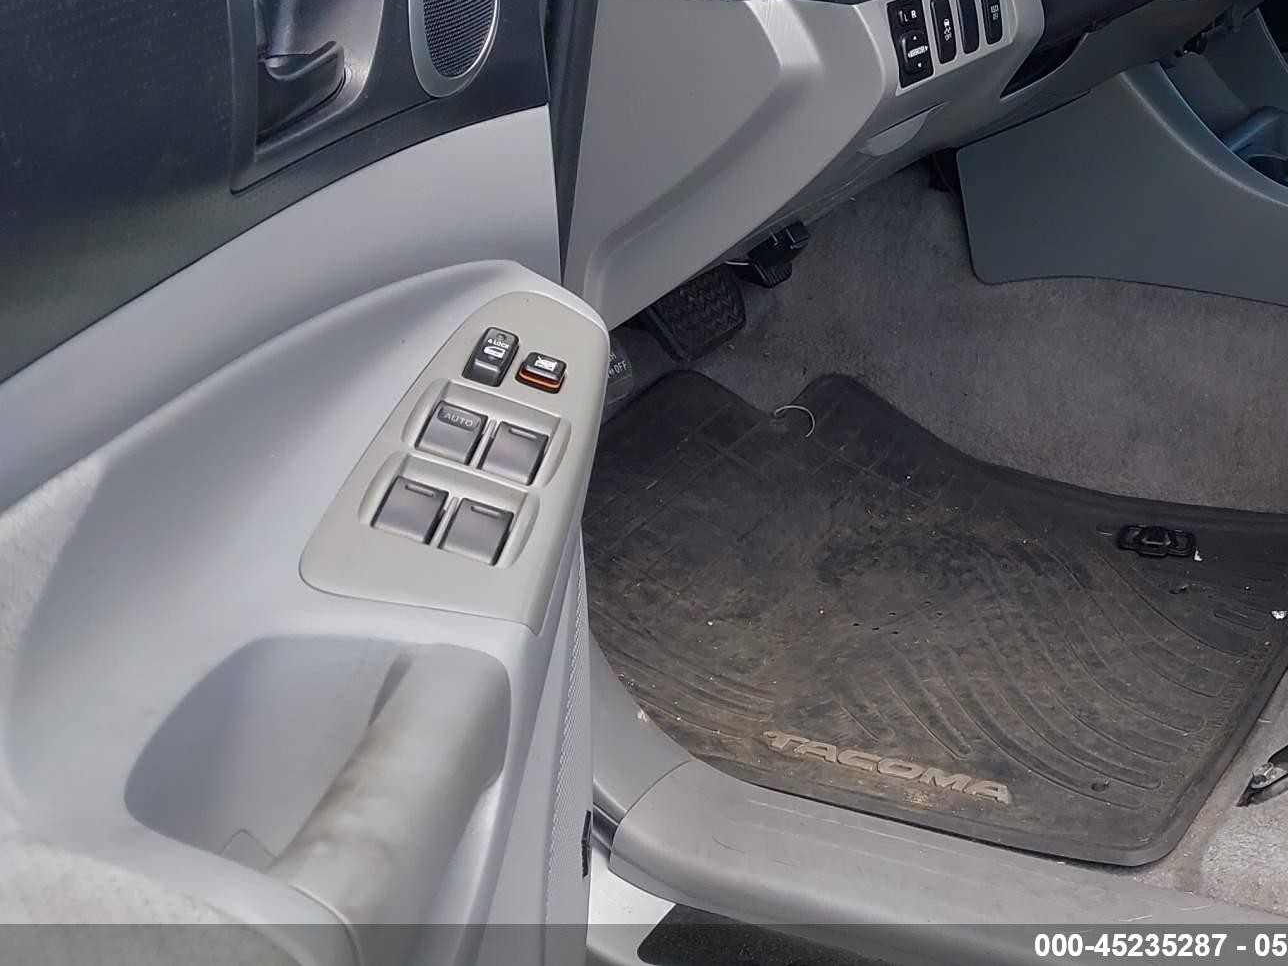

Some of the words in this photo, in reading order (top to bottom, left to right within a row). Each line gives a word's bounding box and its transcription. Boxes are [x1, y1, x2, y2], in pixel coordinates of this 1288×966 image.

[493, 339, 510, 349] LOCK
[443, 412, 474, 427] AUTO
[762, 730, 1013, 805] TACOMA
